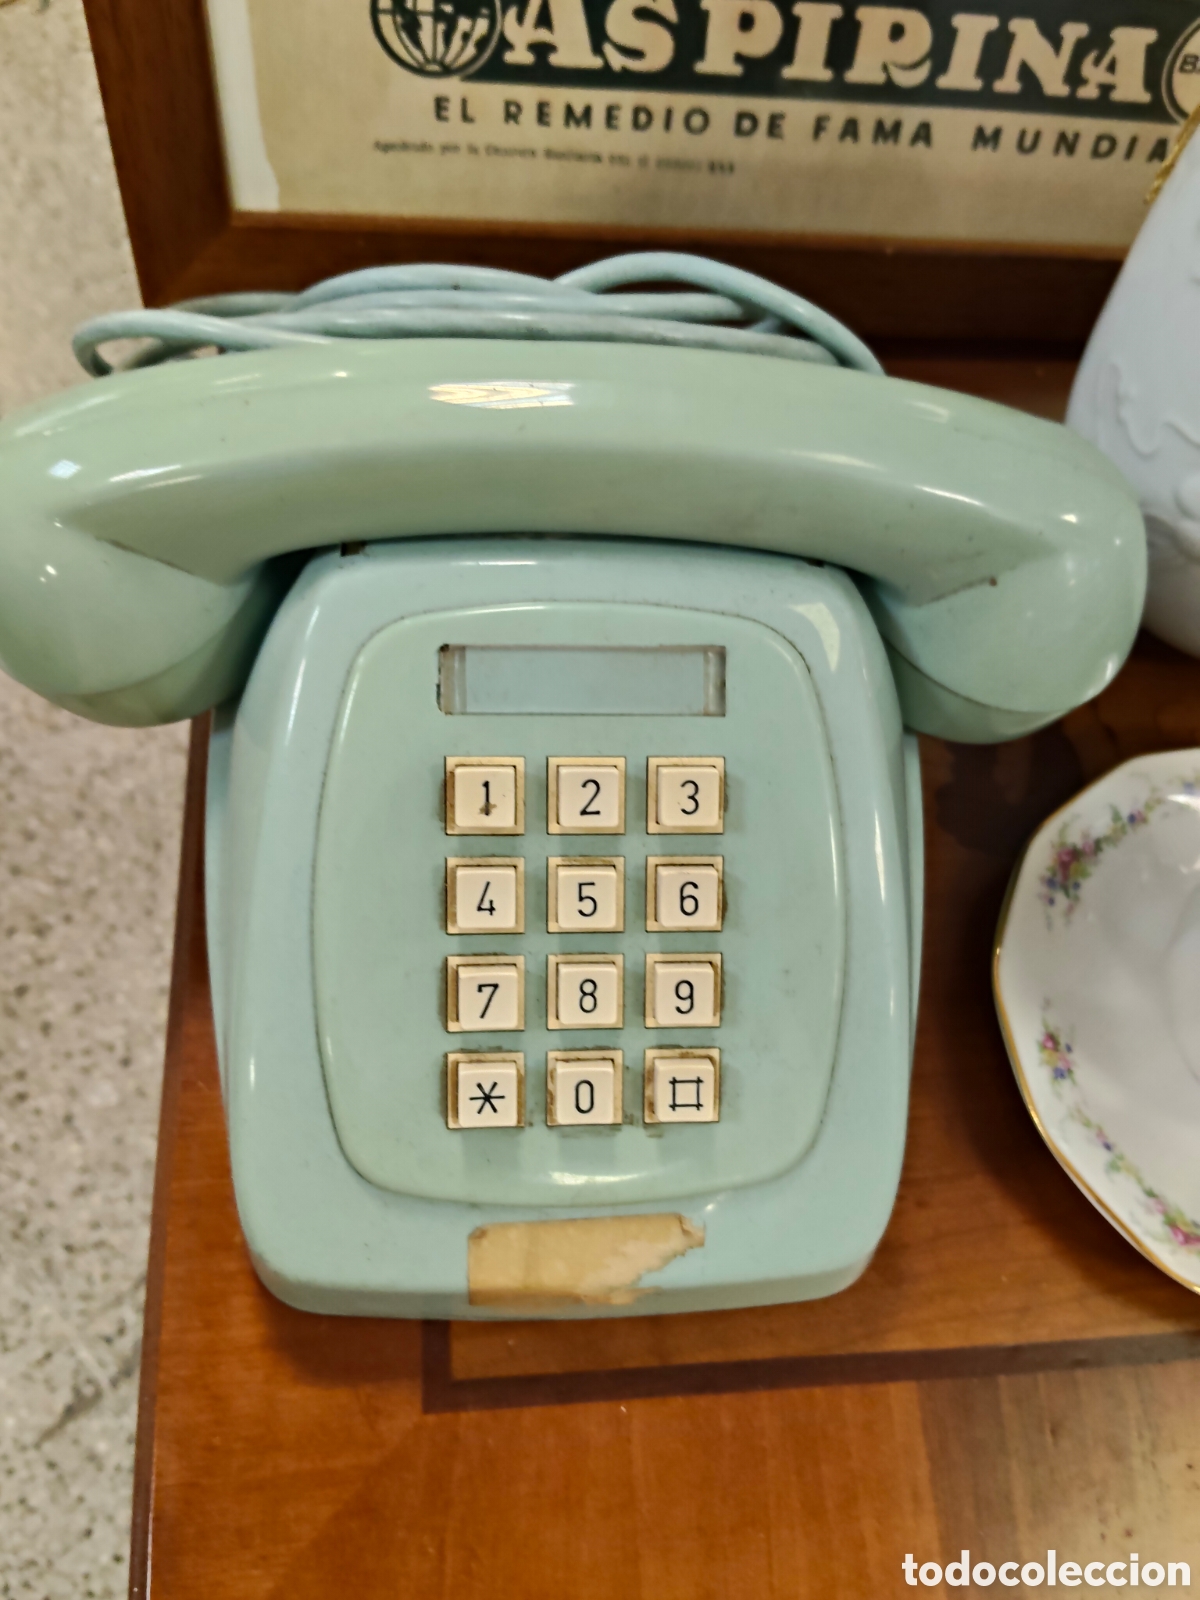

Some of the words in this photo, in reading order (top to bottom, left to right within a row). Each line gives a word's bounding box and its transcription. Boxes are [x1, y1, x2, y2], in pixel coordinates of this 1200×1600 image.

[502, 0, 1158, 104] ASPIRINA
[433, 96, 476, 124] EL
[503, 100, 710, 135] REMEDIO
[734, 111, 786, 140] DE
[812, 115, 933, 149] FAMA
[480, 780, 491, 817] 1
[579, 778, 601, 816] 2
[680, 779, 700, 816] 3
[476, 881, 496, 916] 4
[577, 881, 598, 918] 5
[679, 881, 699, 917] 6
[477, 982, 500, 1019] 7
[579, 978, 598, 1014] 8
[674, 979, 694, 1015] 9
